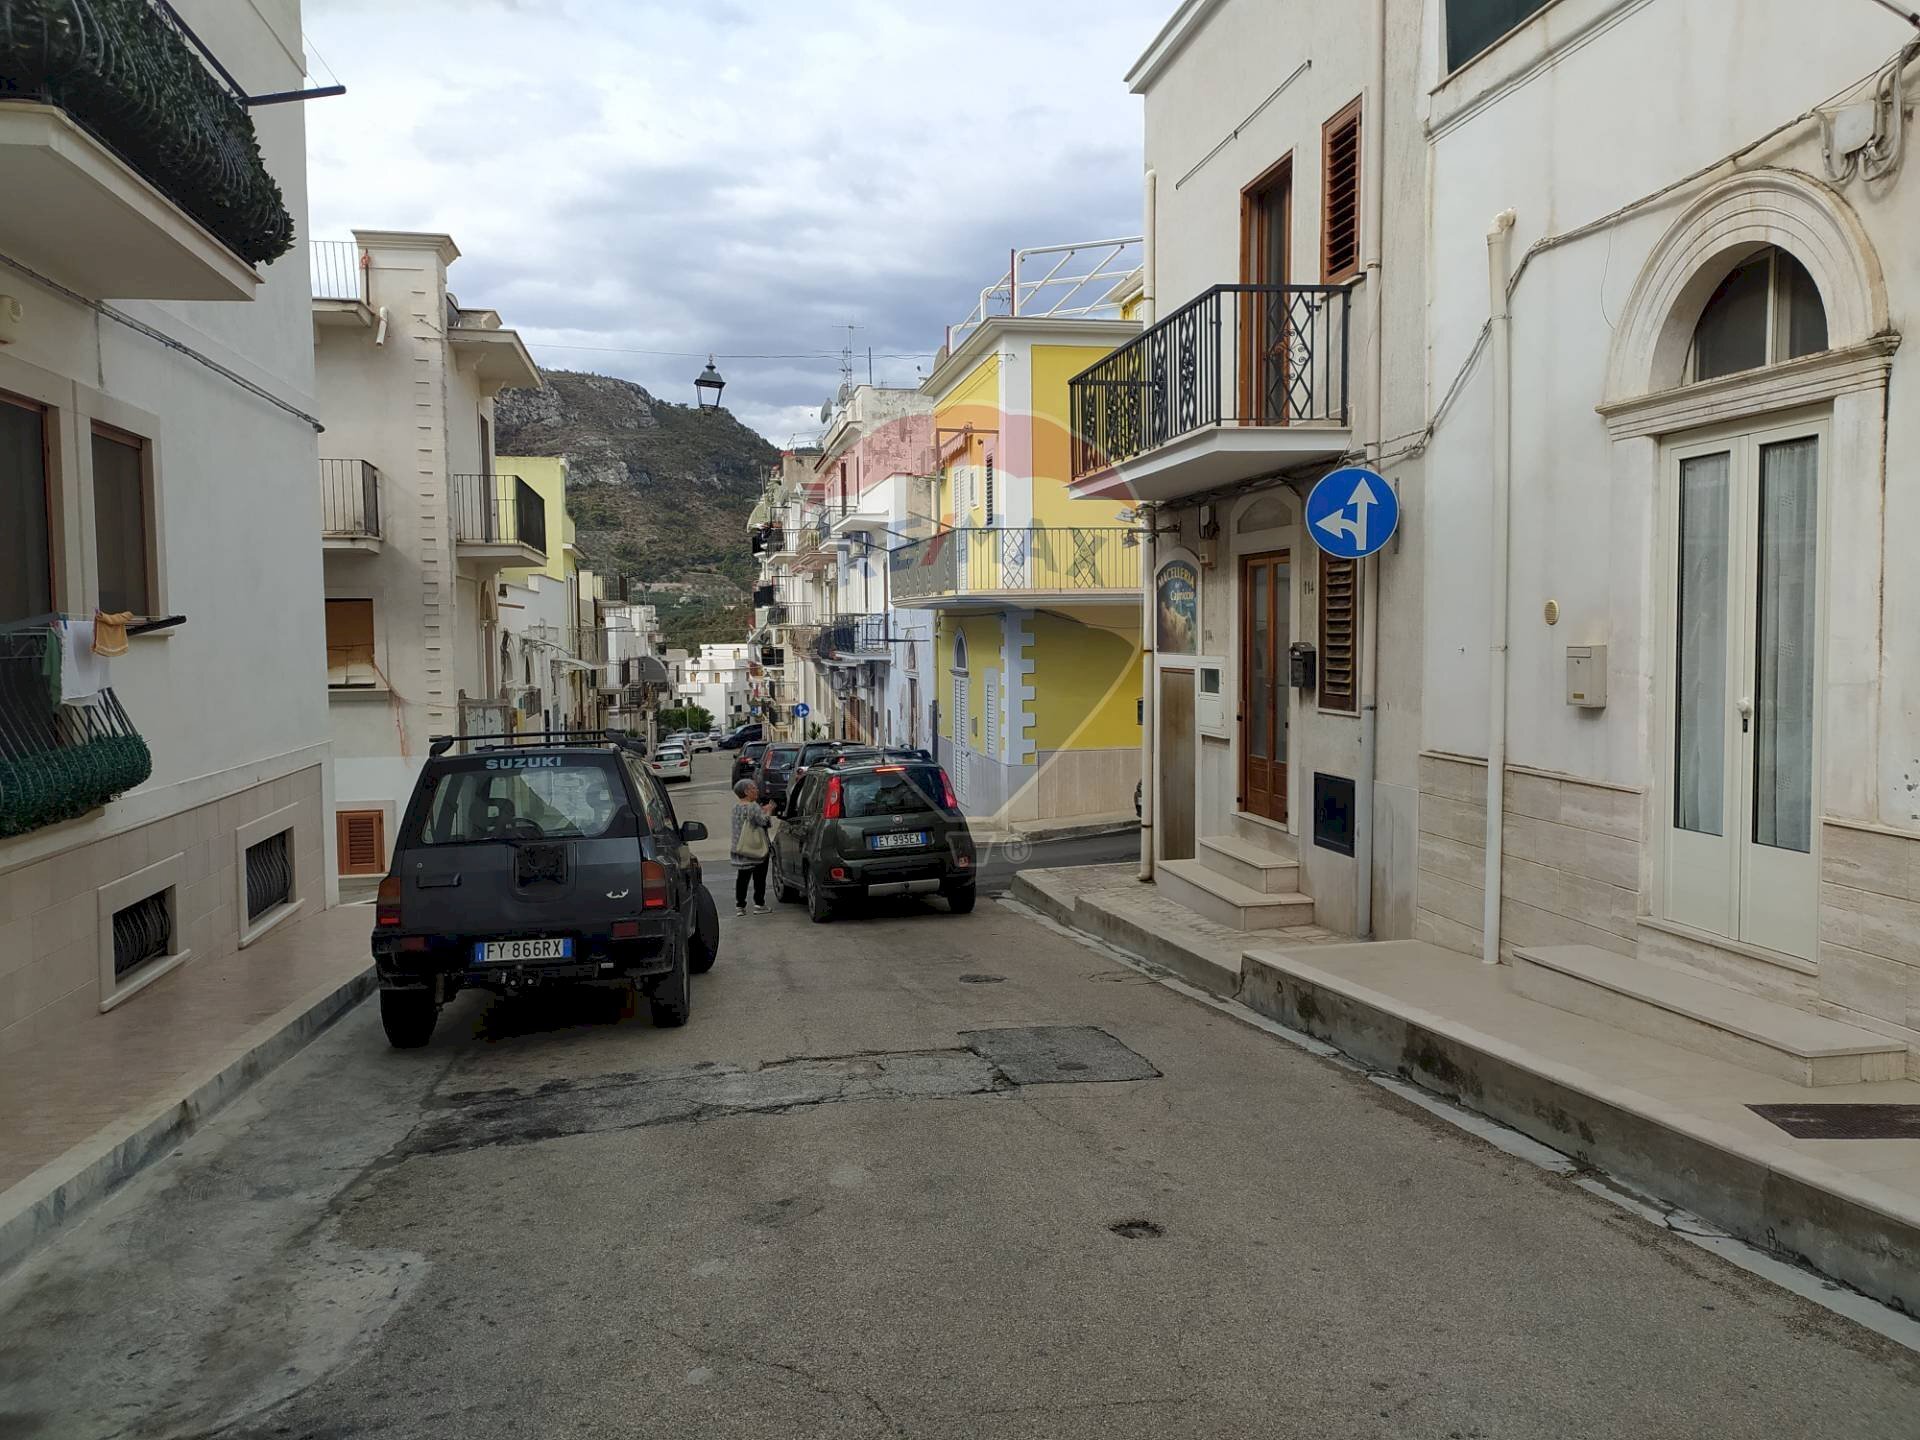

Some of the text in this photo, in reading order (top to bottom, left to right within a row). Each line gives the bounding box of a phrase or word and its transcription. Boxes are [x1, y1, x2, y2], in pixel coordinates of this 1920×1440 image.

[1158, 567, 1195, 588] MACELLERIA
[486, 756, 562, 770] SUZUKI
[879, 835, 889, 846] EY
[486, 940, 561, 959] FY 866RX
